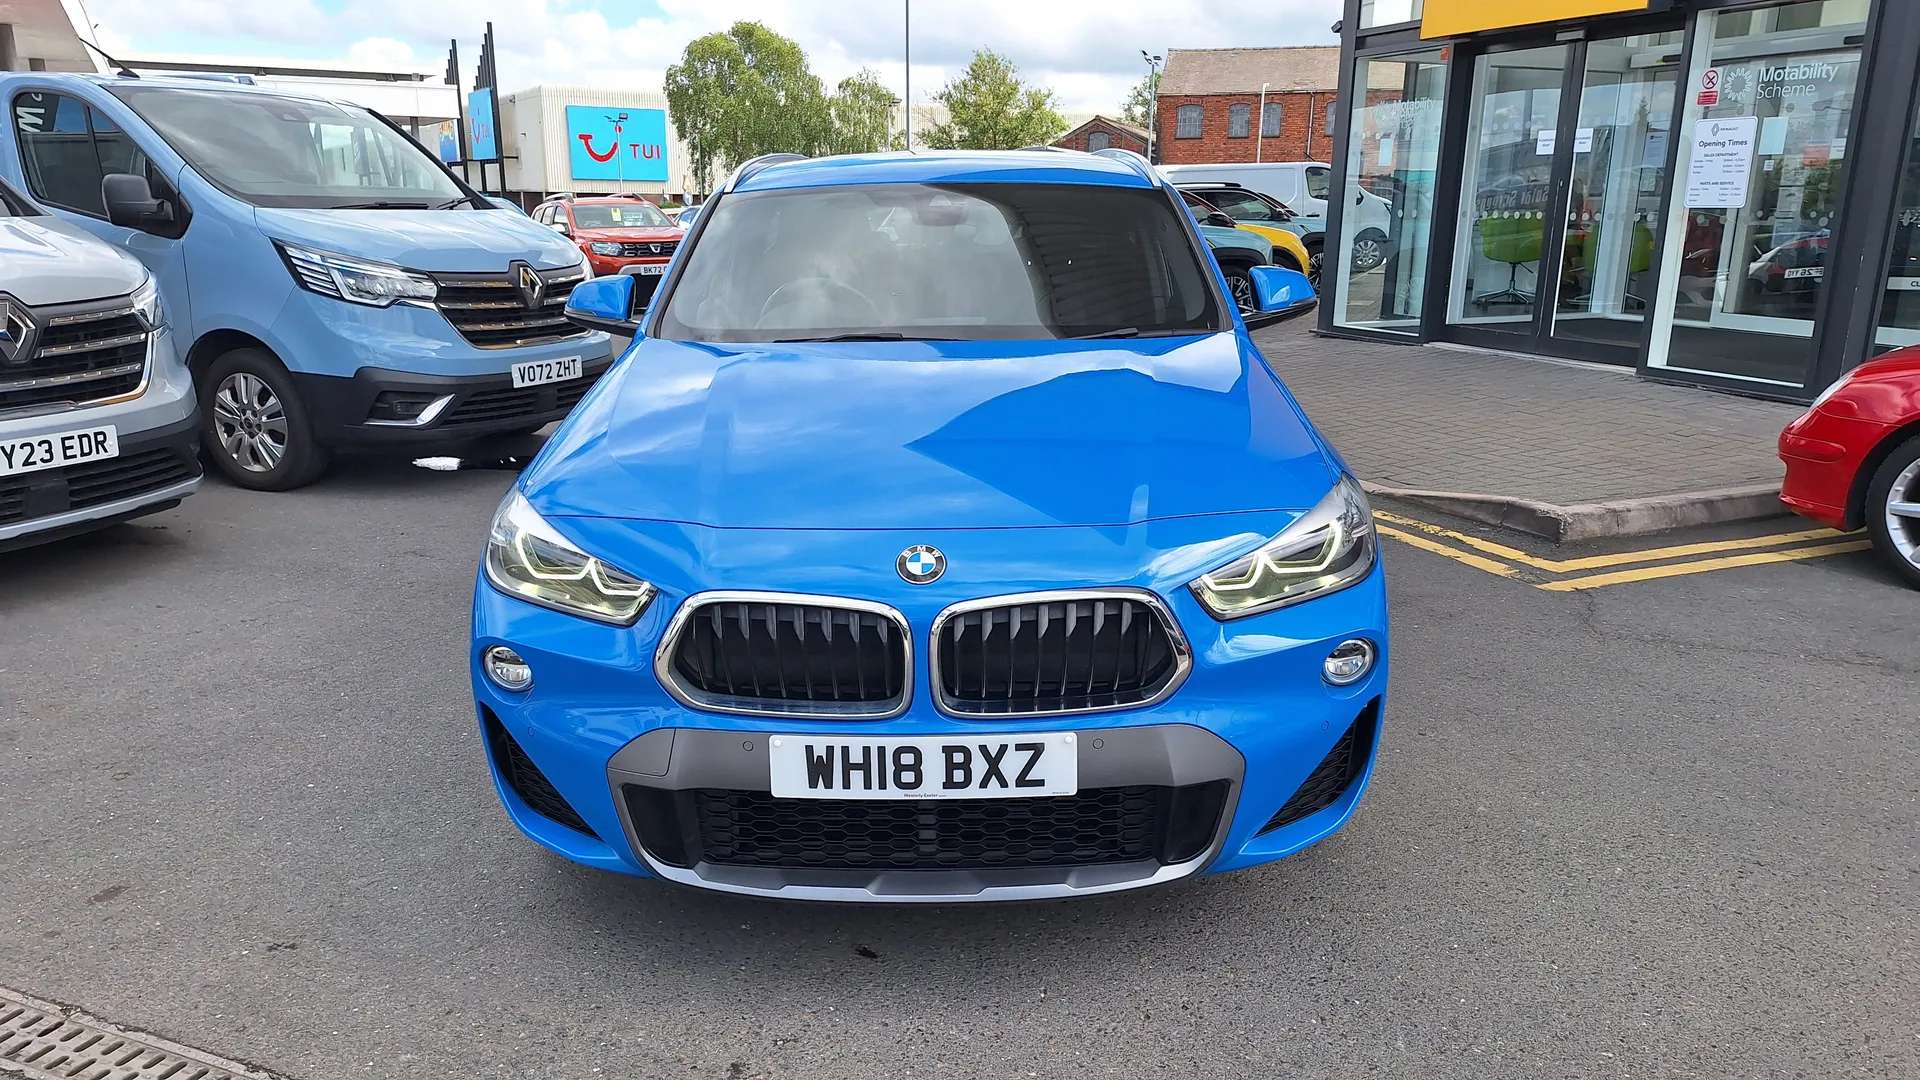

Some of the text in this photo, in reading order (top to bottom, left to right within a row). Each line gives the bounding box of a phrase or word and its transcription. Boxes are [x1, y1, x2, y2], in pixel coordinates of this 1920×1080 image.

[1759, 62, 1839, 82] Motability
[1756, 82, 1816, 99] Scheme
[629, 144, 660, 160] TUI
[1698, 140, 1726, 148] Opening
[643, 266, 662, 274] BK72
[518, 359, 577, 384] VO72 ZHT
[60, 431, 108, 460] EDR
[902, 545, 941, 558] BMW
[804, 742, 1045, 790] WH18 BXZ
